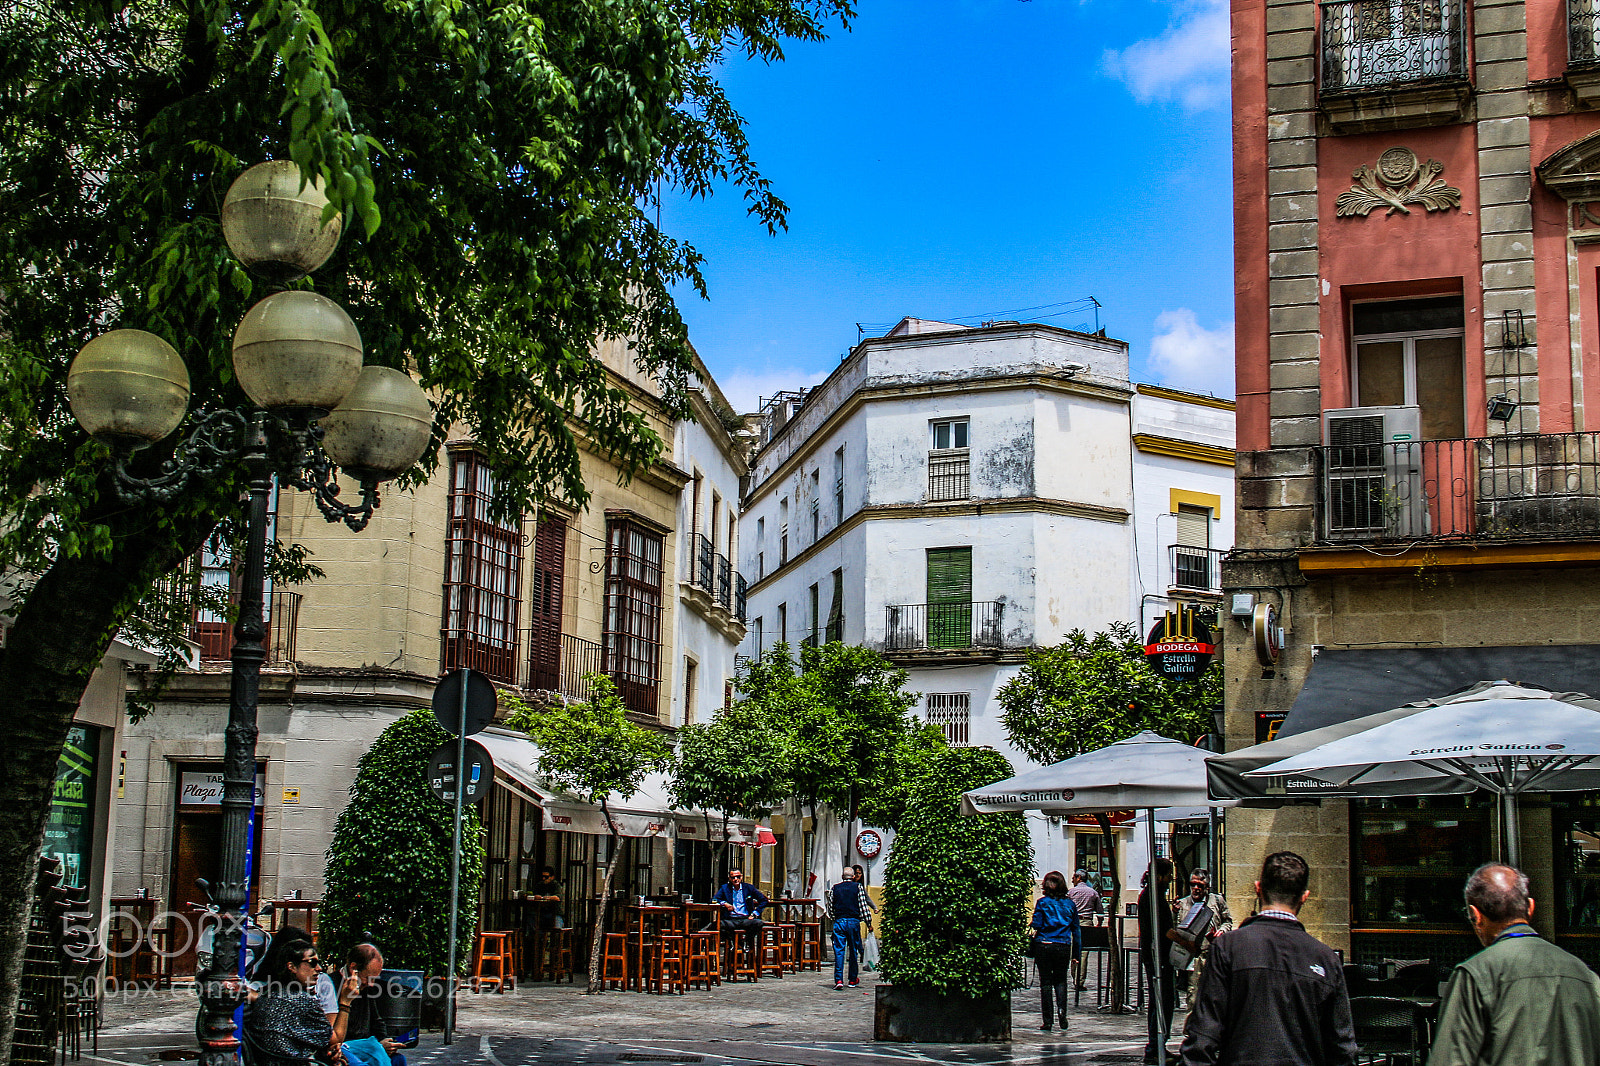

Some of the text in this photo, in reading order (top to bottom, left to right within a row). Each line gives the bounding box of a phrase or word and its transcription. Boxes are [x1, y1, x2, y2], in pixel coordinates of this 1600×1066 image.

[1156, 643, 1199, 652] BODEGA
[1162, 654, 1196, 663] Estrella
[1163, 663, 1195, 673] Galicia
[1408, 743, 1542, 756] Estrella Galicia
[1286, 779, 1318, 788] Estrella
[183, 784, 217, 802] Plaza
[974, 790, 1060, 806] Estrella Galicia
